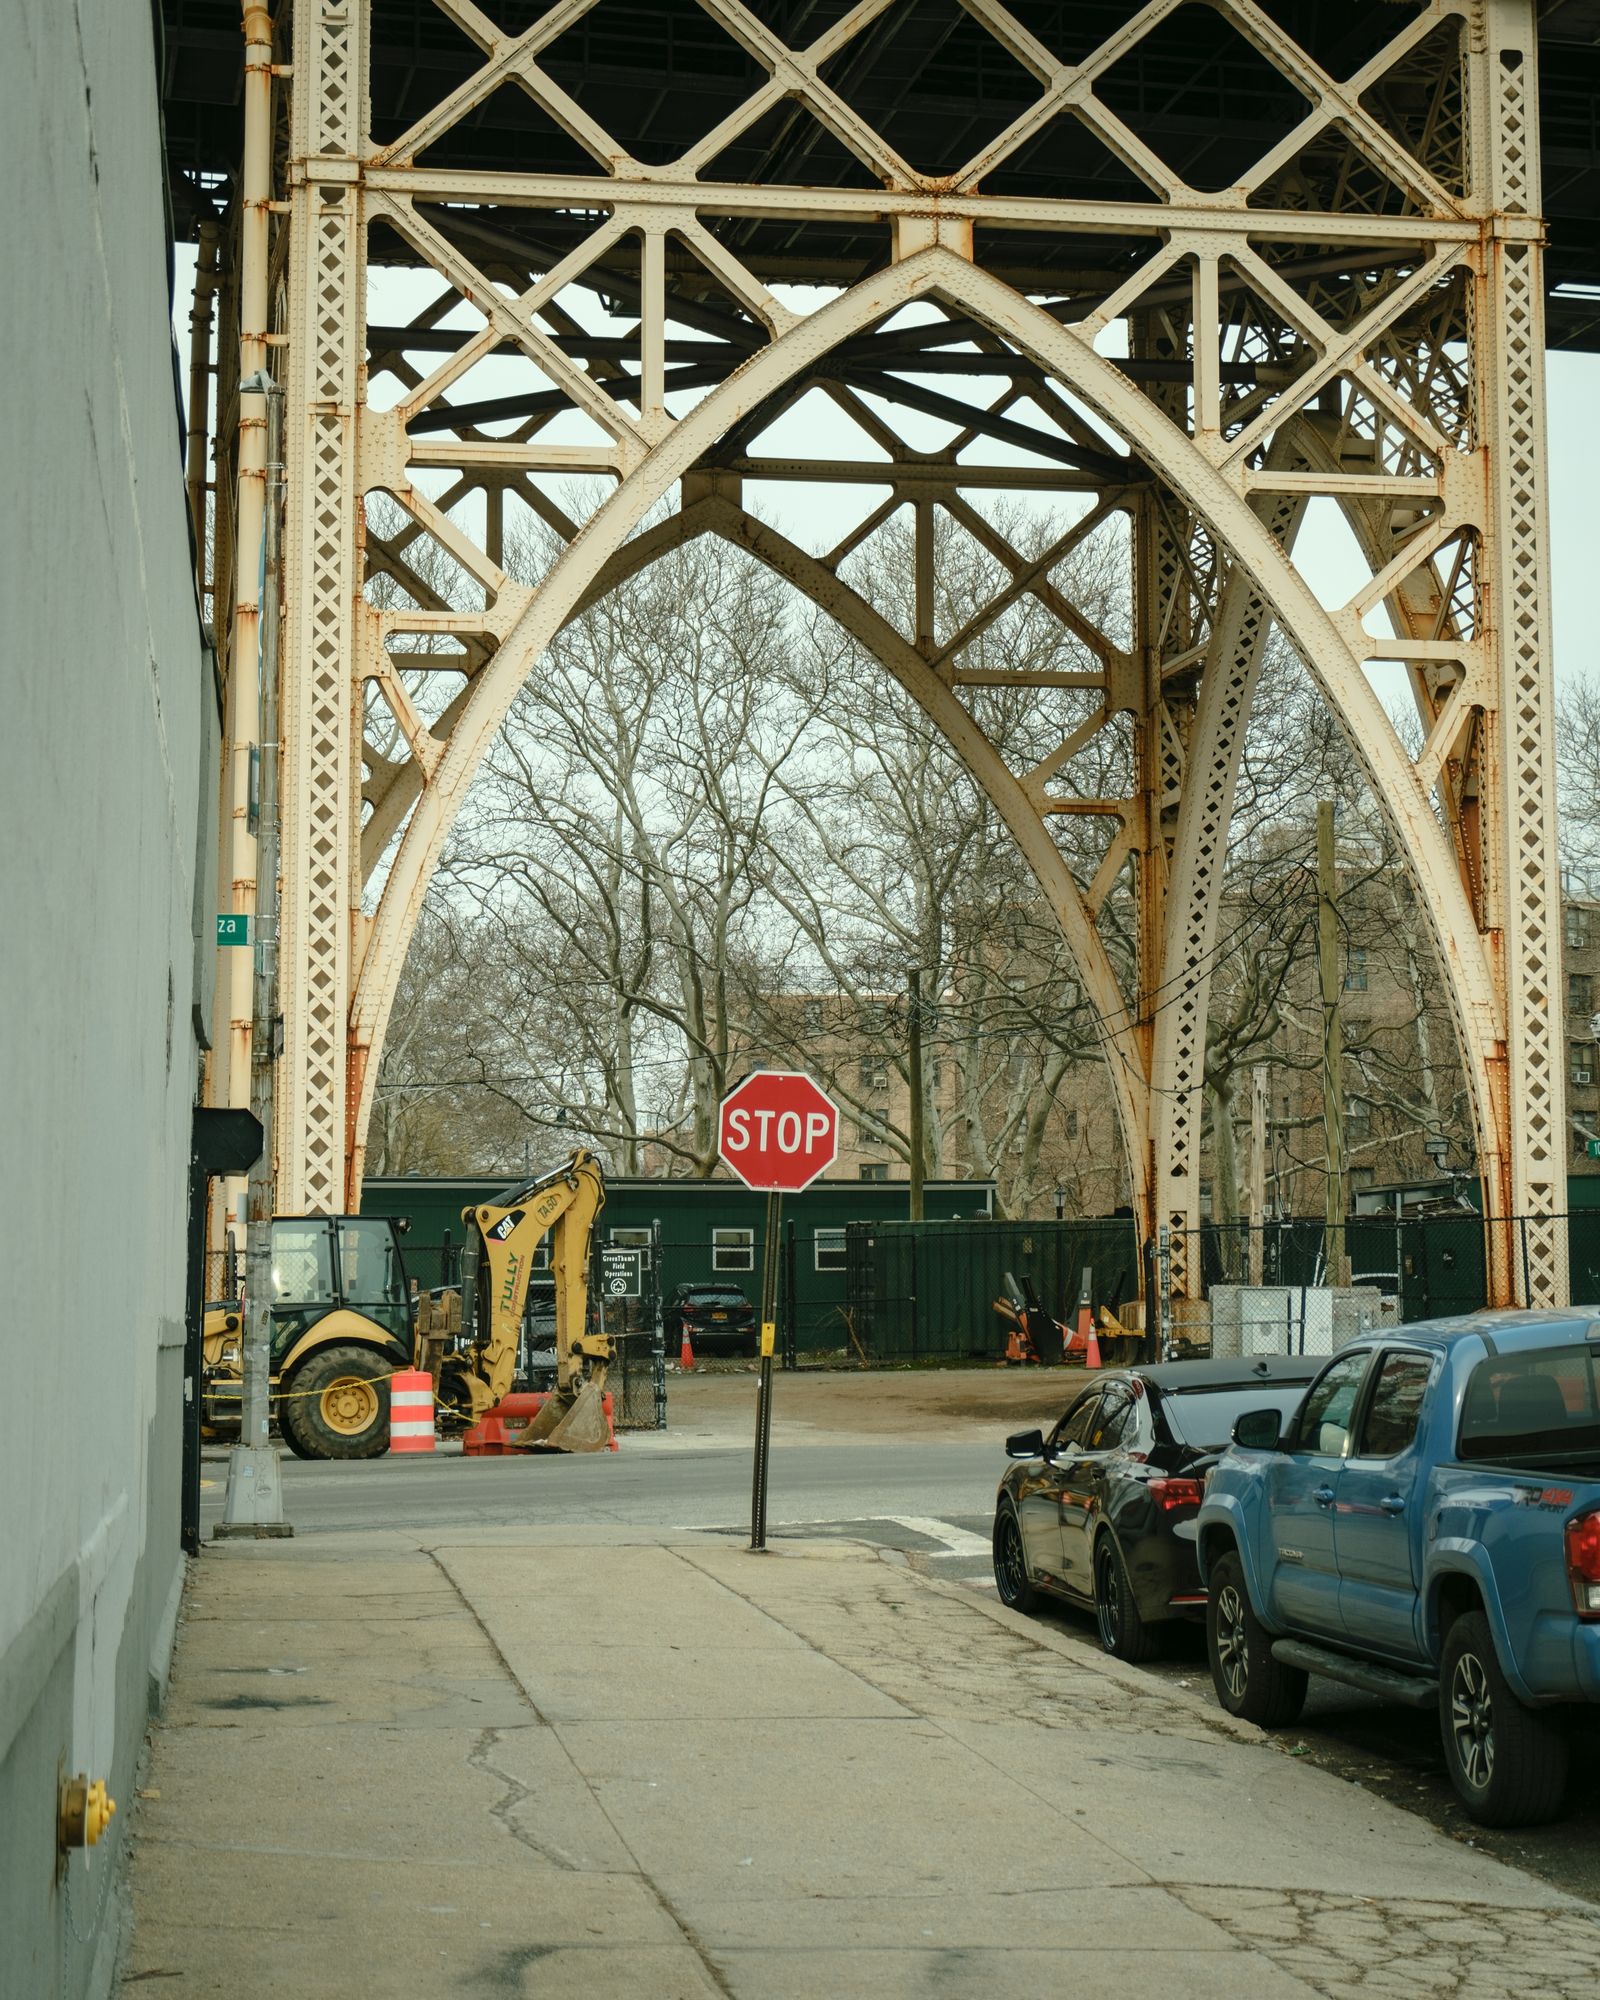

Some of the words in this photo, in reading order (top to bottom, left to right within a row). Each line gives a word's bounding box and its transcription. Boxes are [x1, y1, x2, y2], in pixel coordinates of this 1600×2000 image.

[727, 1108, 830, 1154] STOP
[496, 1214, 515, 1240] CAT
[602, 1255, 635, 1263] GreenThumb
[612, 1262, 626, 1270] Field
[500, 1250, 519, 1311] TULLY
[604, 1270, 633, 1279] Operations
[510, 1254, 526, 1316] CONSTRUCTION
[1537, 1502, 1569, 1515] SPORT
